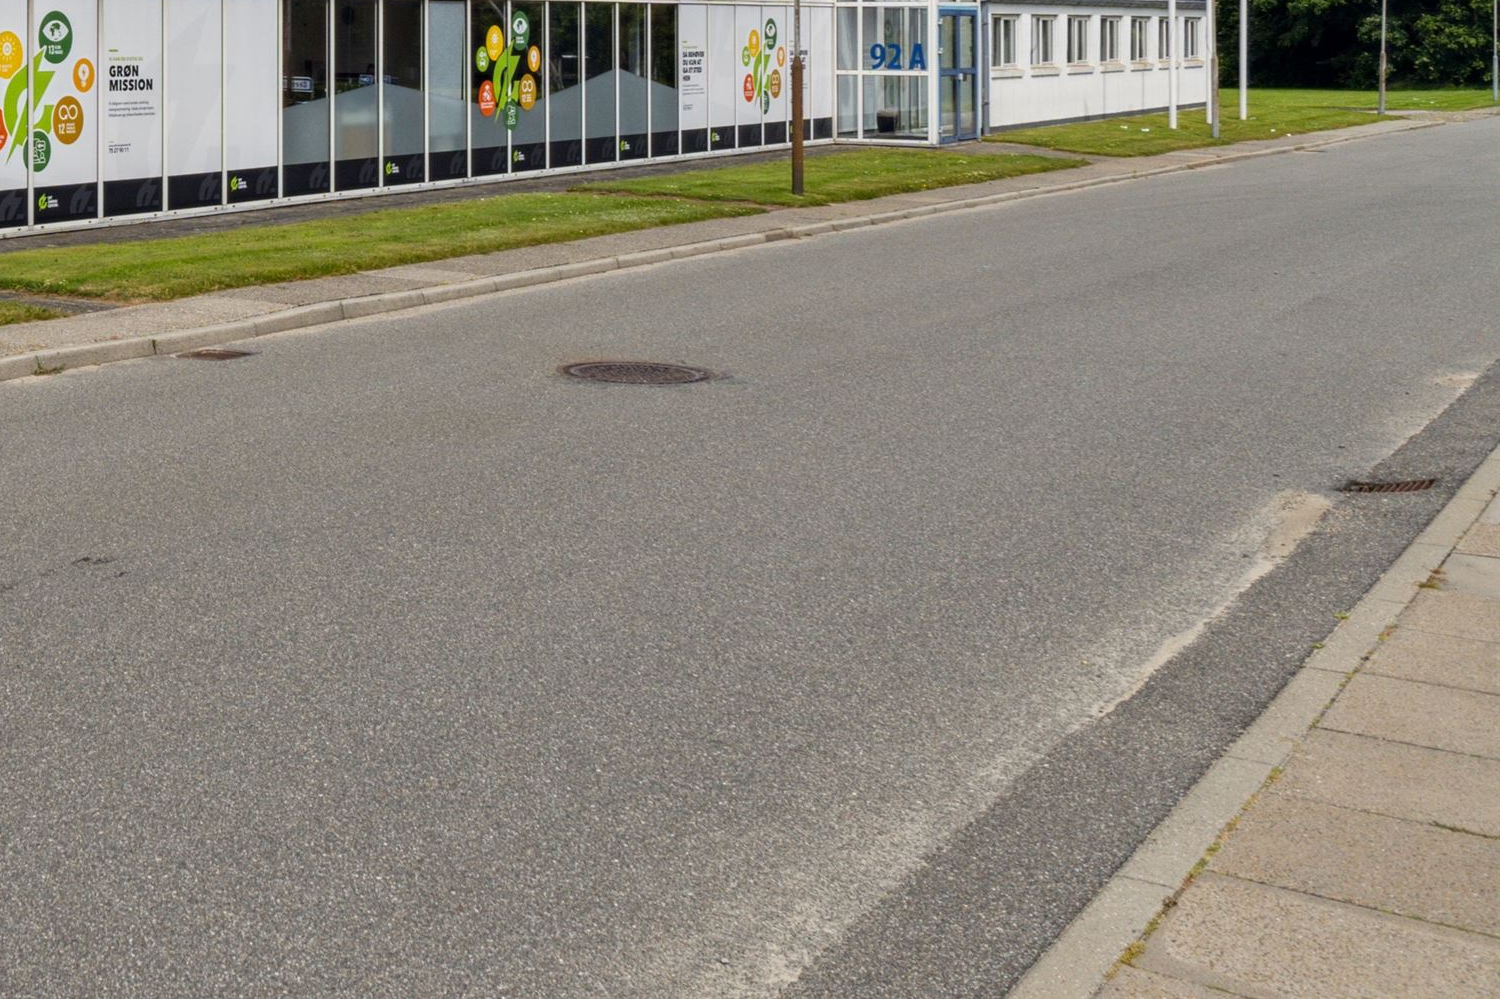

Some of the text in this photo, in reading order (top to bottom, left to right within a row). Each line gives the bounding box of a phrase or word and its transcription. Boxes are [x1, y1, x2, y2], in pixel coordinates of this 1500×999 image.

[870, 43, 926, 70] 92 A
[109, 64, 139, 78] GRØN
[109, 78, 153, 92] MISSION
